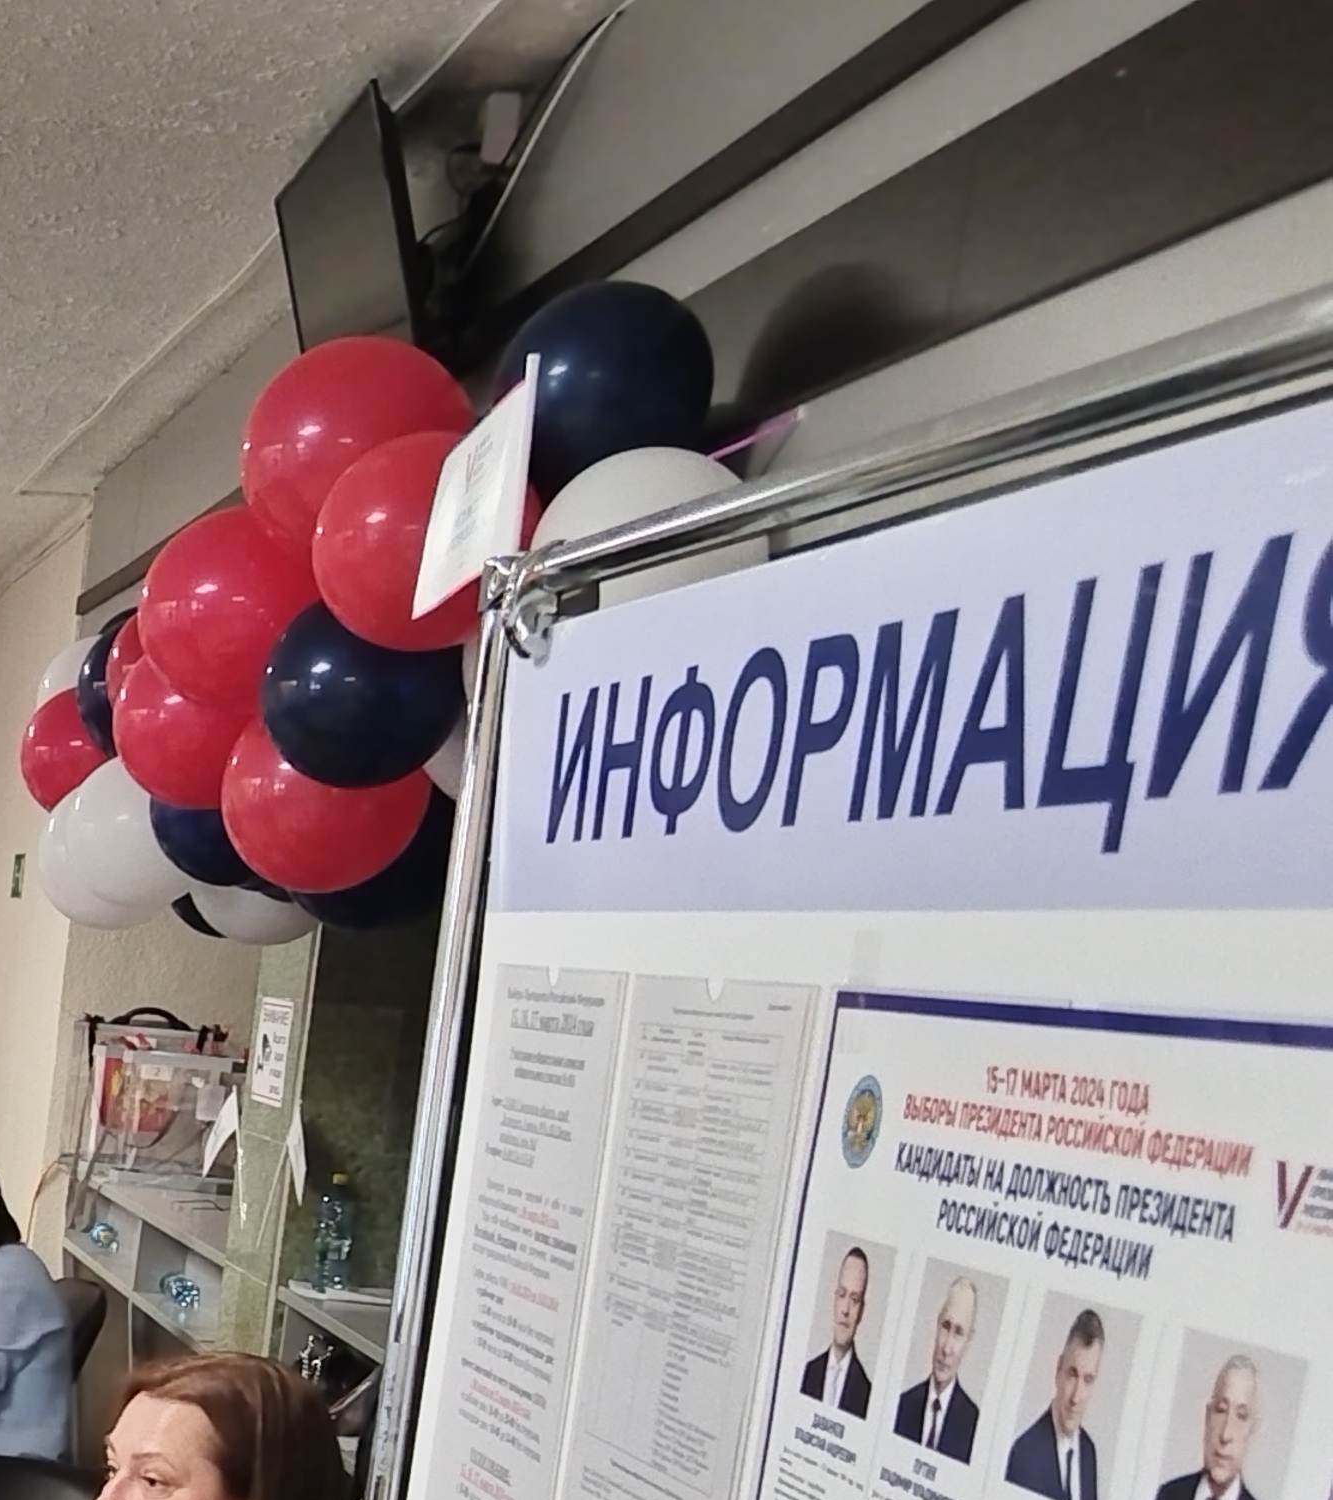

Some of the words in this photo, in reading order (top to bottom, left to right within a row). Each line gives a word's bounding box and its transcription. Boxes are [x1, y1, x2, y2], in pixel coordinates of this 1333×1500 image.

[545, 531, 1333, 854] ИНФОРМАЦИЯ
[985, 1066, 1019, 1095] 15-17
[1020, 1069, 1067, 1103] МАРТА
[1070, 1075, 1106, 1109] 2024
[1109, 1080, 1150, 1116] ГОДА
[903, 1094, 958, 1128] ВЫБОРЫ
[959, 1101, 1043, 1141] ПРЕЗИДЕНТА
[1045, 1114, 1146, 1159] РОССИЙСКОЙ
[1146, 1129, 1255, 1178] ФЕДЕРАЦИИ
[895, 1142, 981, 1187] КАНДИДАТЫ
[982, 1157, 1005, 1194] НА
[1005, 1163, 1111, 1215] ДОЛЖНОСТЬ
[1114, 1184, 1237, 1243] ПРЕЗИДЕНТА
[936, 1198, 1043, 1253] РОССИЙСКОЙ
[1043, 1220, 1154, 1281] ФЕДЕРАЦИИ
